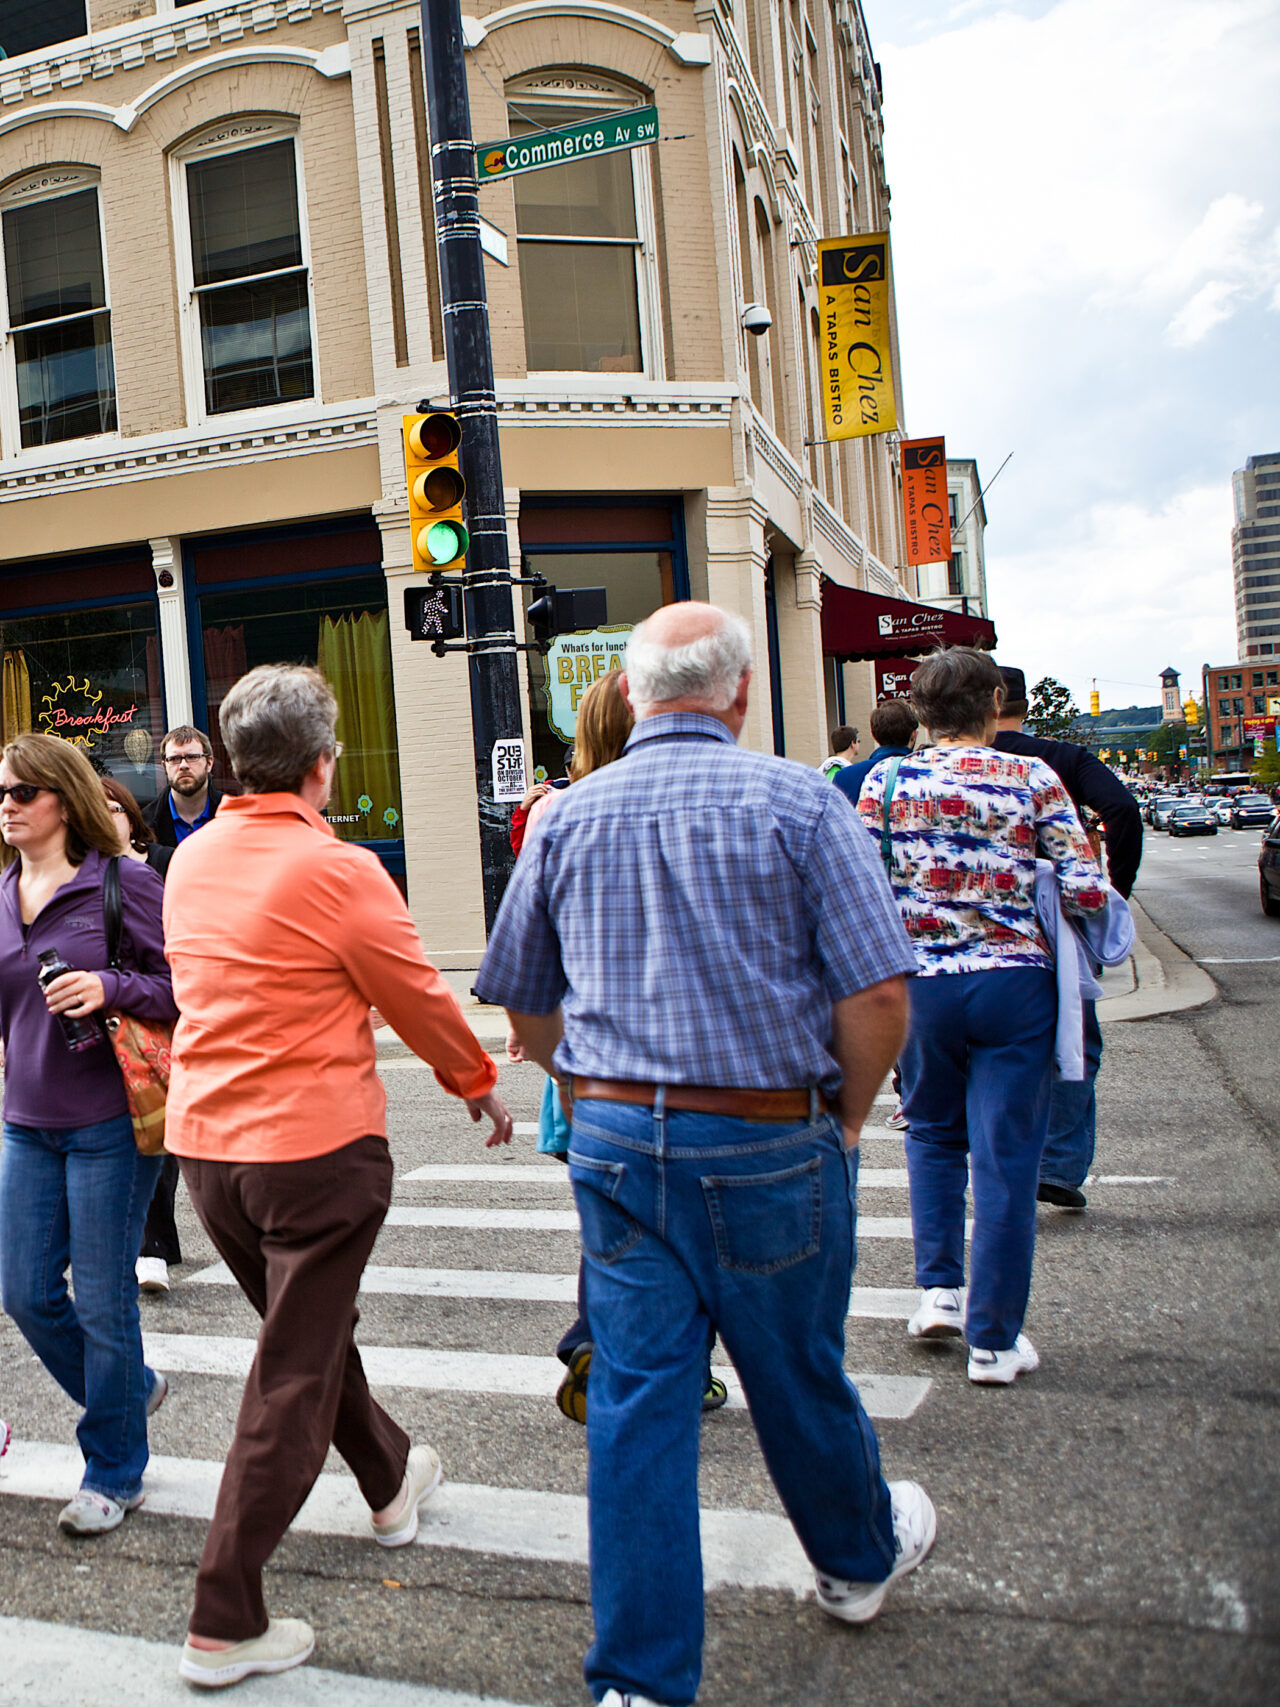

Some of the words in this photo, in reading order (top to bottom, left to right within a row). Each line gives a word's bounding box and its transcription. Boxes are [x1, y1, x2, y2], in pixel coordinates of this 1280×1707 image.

[505, 130, 605, 169] Commerce
[615, 126, 630, 144] Av
[826, 295, 836, 305] A
[842, 251, 881, 328] San
[826, 311, 838, 361] TAPAS
[829, 368, 843, 425] BISTRO
[847, 341, 883, 424] Chez
[917, 446, 944, 494] San
[908, 485, 916, 516] TAPAS
[910, 519, 919, 556] BISTRO
[921, 502, 944, 556] Chez
[880, 616, 907, 628] San
[911, 613, 944, 625] Chez
[561, 643, 589, 653] What's
[592, 642, 603, 652] for
[557, 654, 623, 684] BREA
[884, 673, 907, 685] San
[877, 692, 886, 700] A
[890, 690, 911, 698] TAP
[52, 704, 138, 733] Breakfast
[324, 814, 360, 823] TERNET
